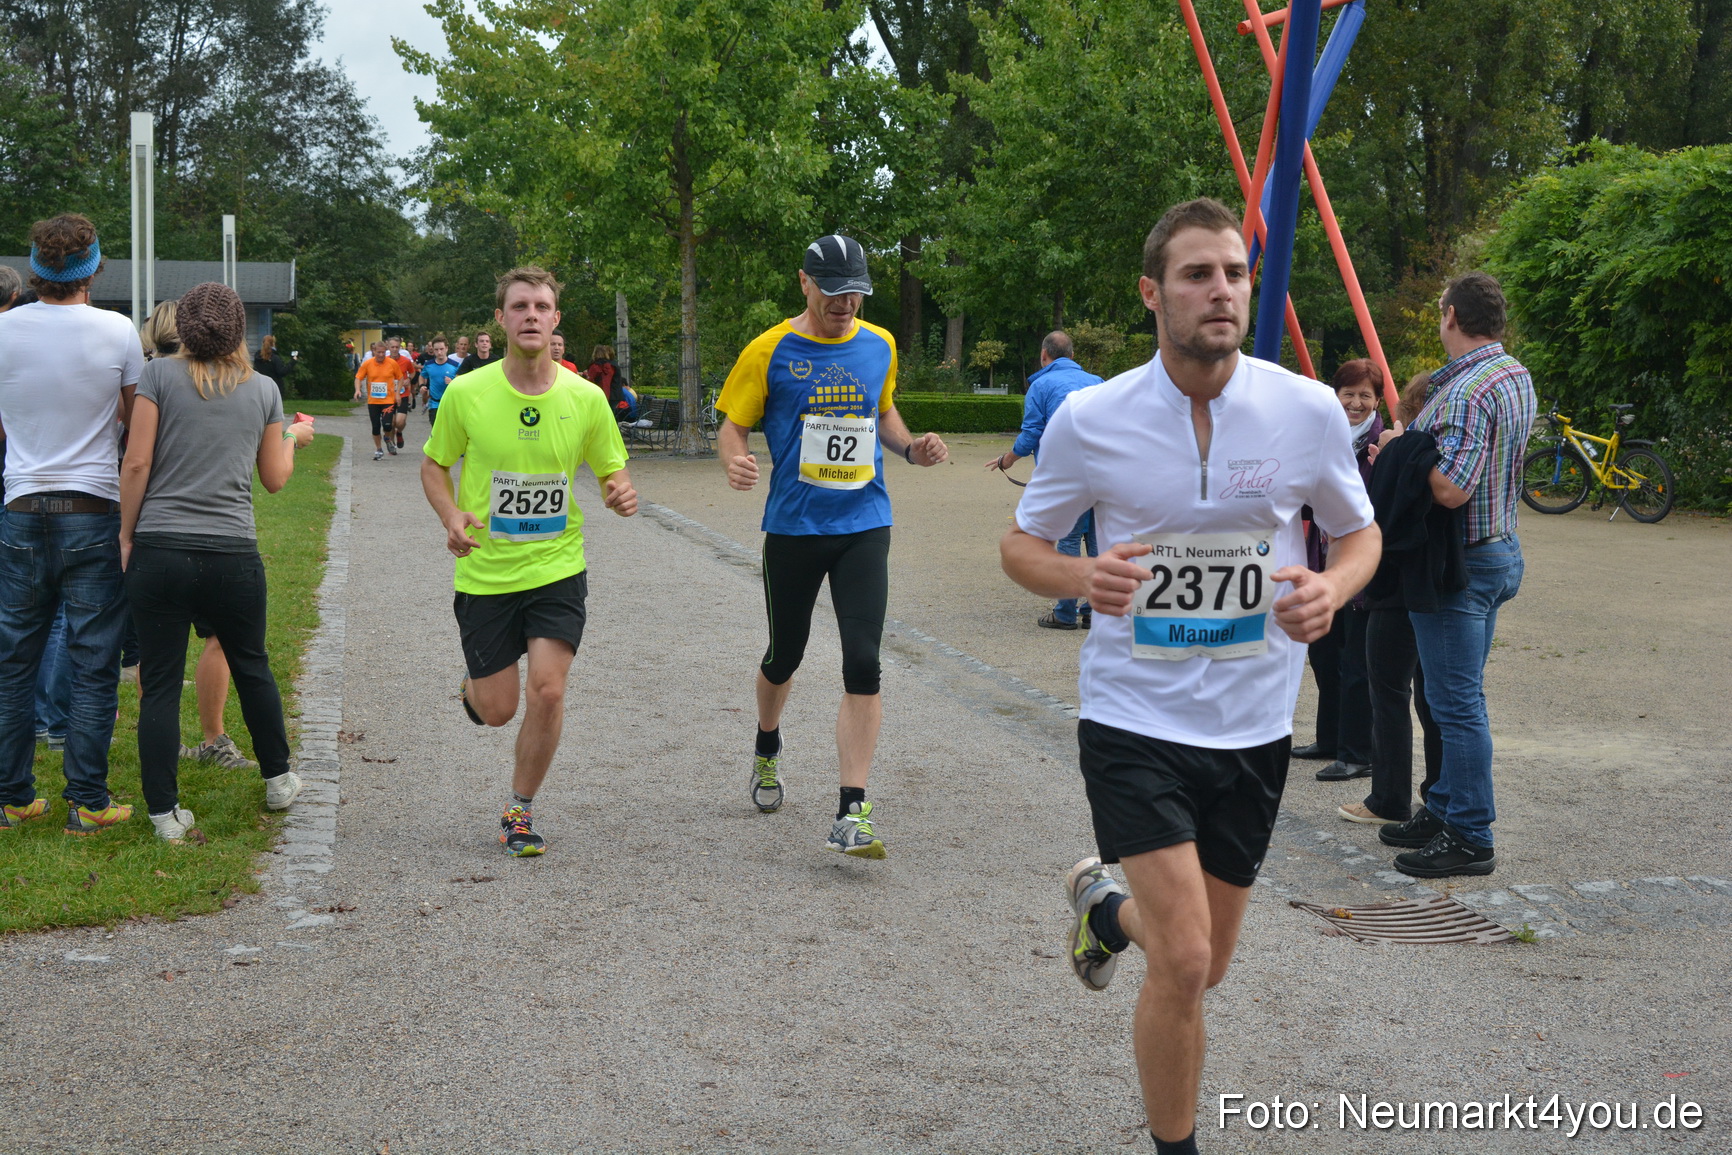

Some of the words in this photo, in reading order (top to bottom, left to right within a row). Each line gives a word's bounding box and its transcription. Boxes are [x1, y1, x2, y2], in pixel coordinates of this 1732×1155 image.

[518, 428, 540, 437] Partl
[805, 422, 831, 431] PARTL
[833, 424, 867, 432] Neumarkt
[826, 434, 858, 462] 62
[818, 467, 857, 480] Michael
[493, 477, 520, 487] PARTL
[498, 489, 564, 515] 2529
[518, 521, 541, 532] Max
[1186, 546, 1252, 558] Neumarkt
[1145, 563, 1263, 611] 2370
[1169, 624, 1236, 643] Manuel
